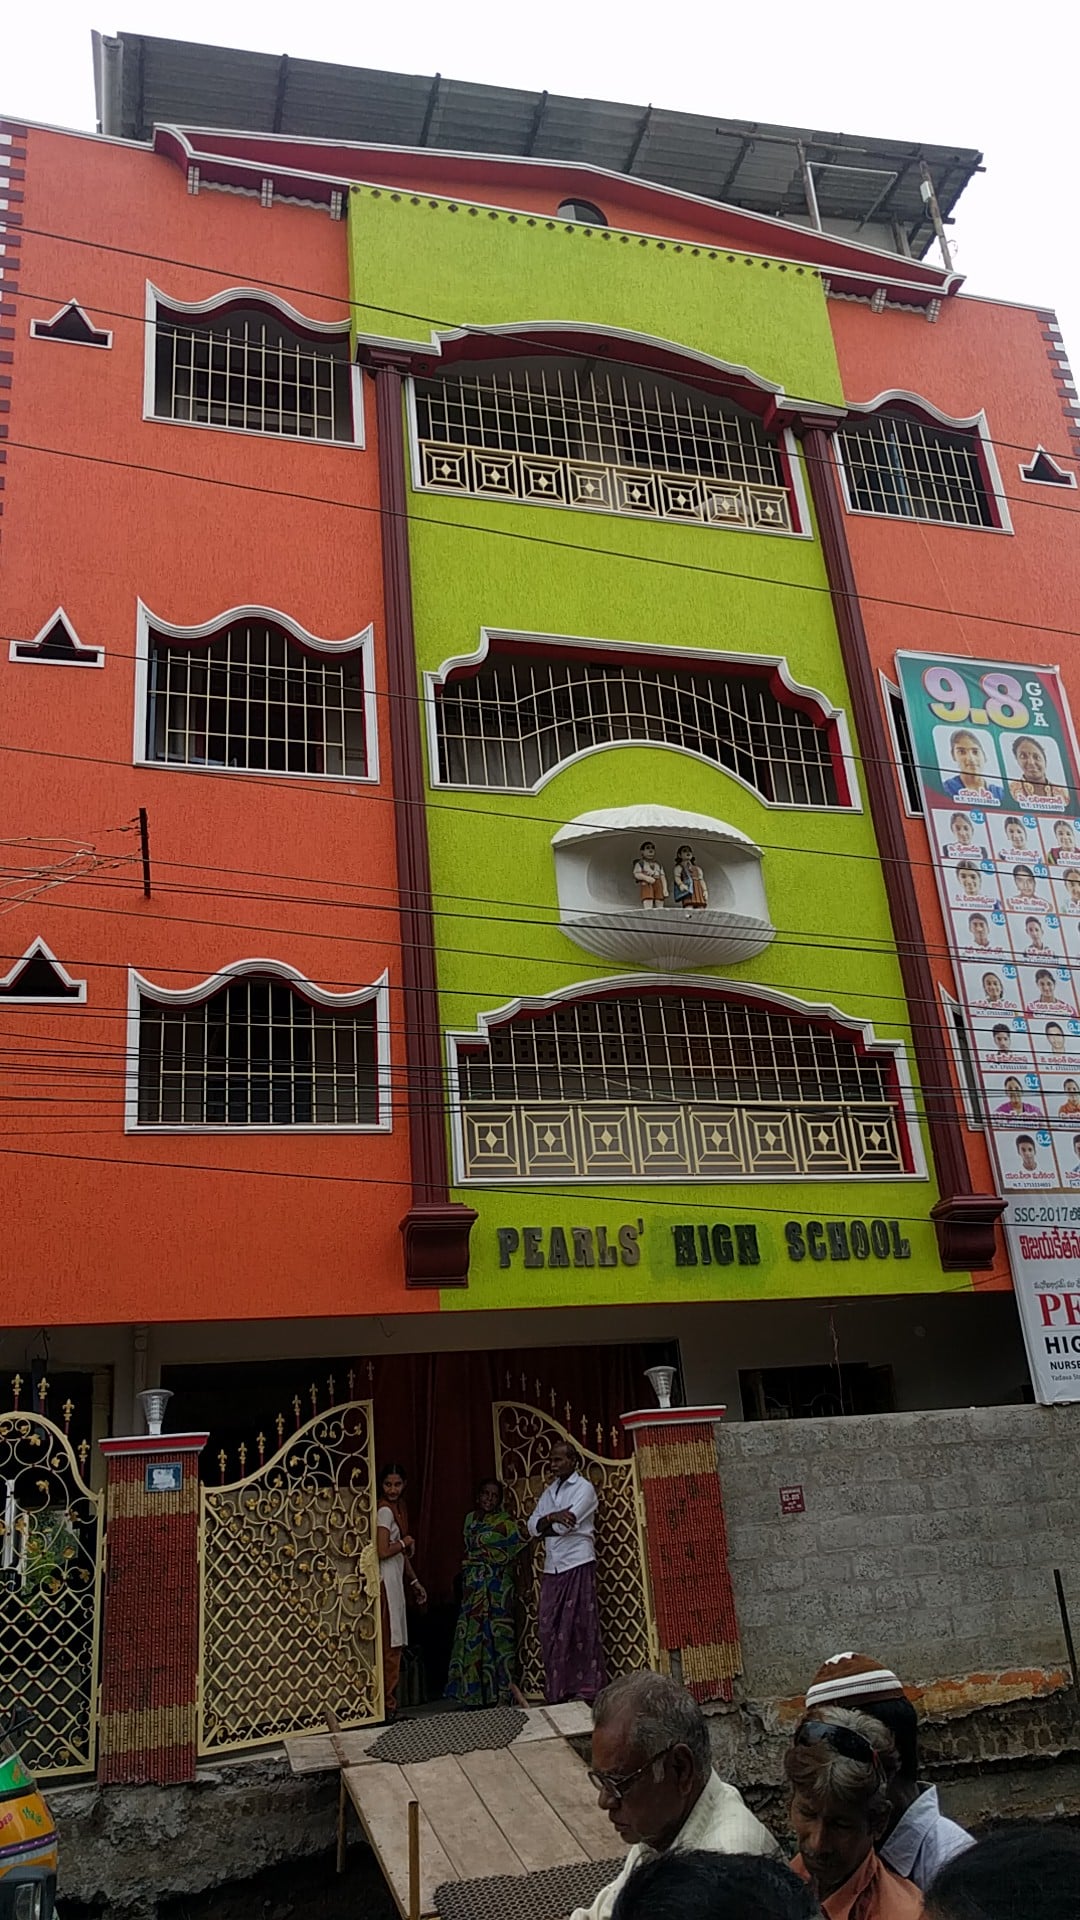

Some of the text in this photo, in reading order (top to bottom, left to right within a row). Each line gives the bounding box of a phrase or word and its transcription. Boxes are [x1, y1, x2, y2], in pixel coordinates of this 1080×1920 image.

[922, 666, 1030, 729] 9.8
[1025, 682, 1049, 727] GPA
[1023, 817, 1037, 825] 9.5
[497, 1219, 911, 1268] PEARLS' HIGH SCHOOL
